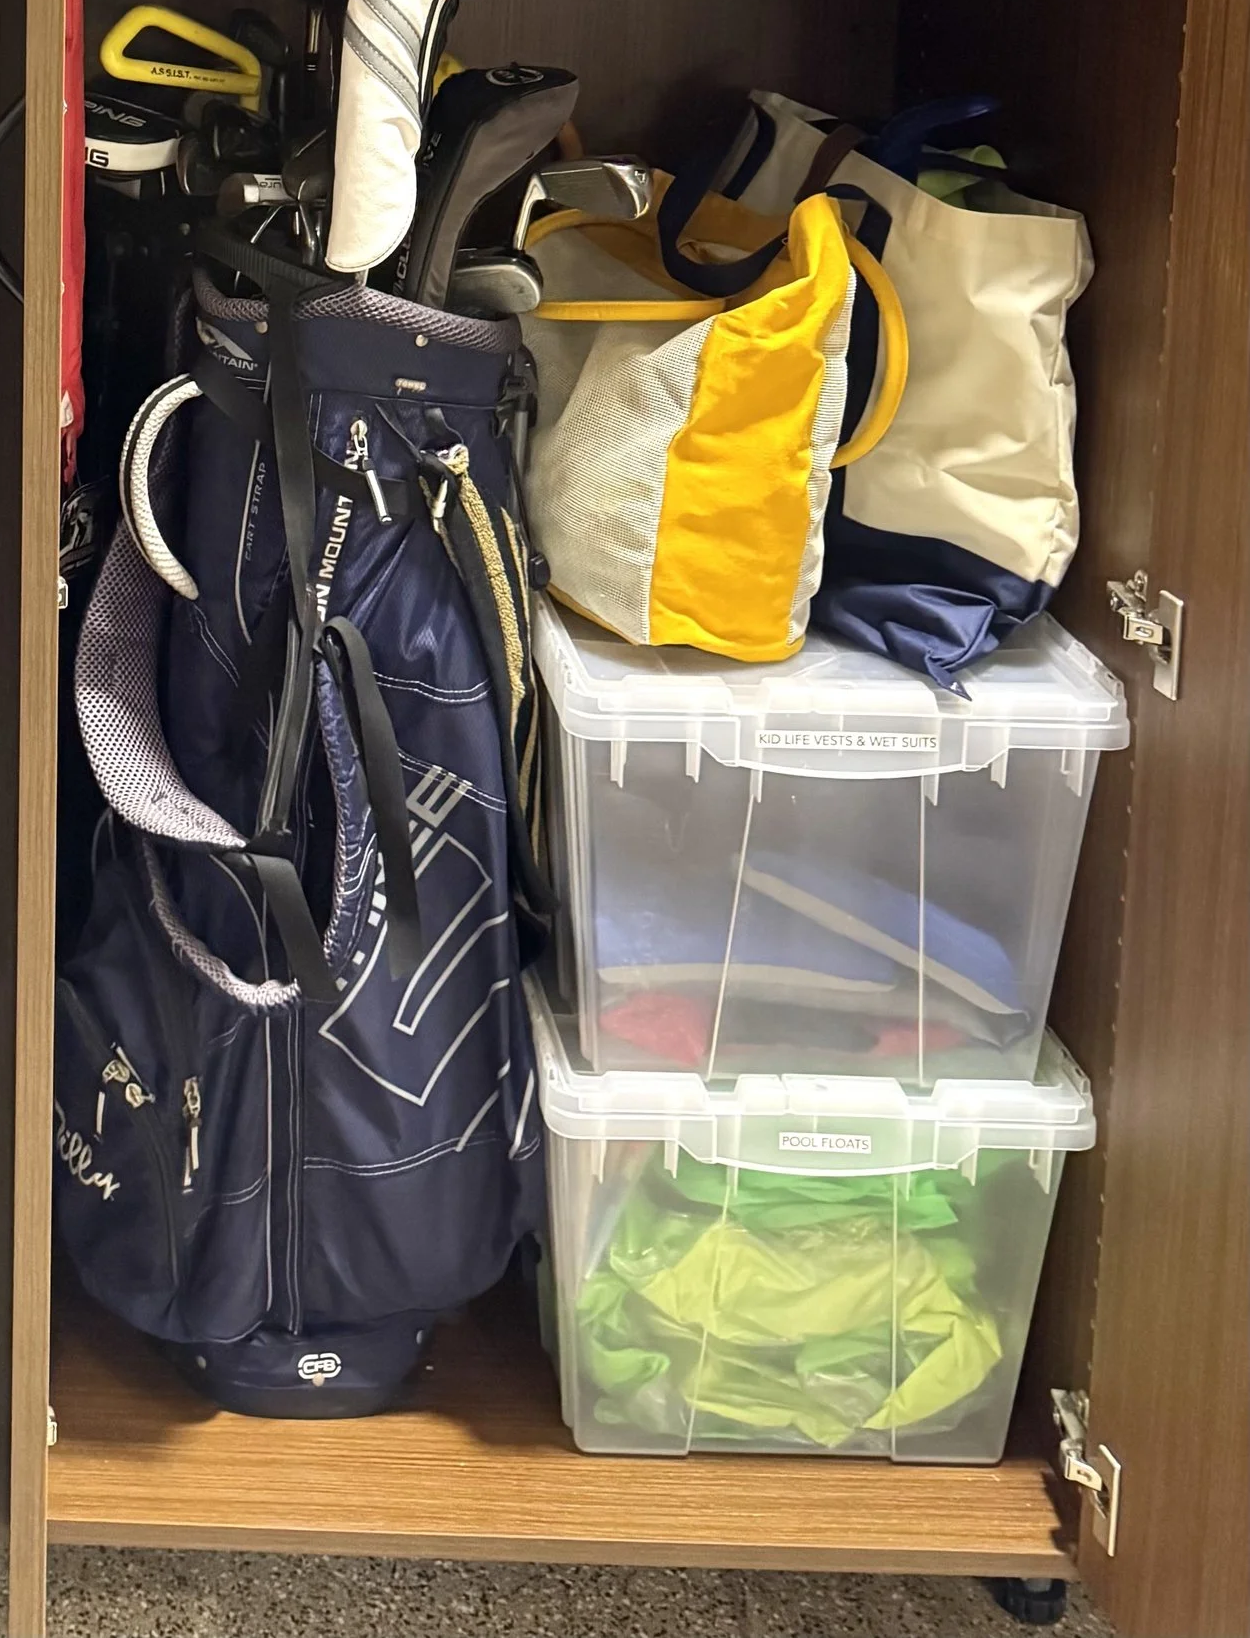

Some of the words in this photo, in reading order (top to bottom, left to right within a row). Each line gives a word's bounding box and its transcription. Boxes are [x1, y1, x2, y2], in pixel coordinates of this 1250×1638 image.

[251, 462, 266, 514] STRAP
[759, 733, 781, 745] KID
[784, 734, 811, 746] LIFE
[814, 735, 853, 747] VESTS
[856, 736, 866, 747] &
[869, 736, 898, 748] WET
[902, 737, 938, 749] SUITS
[782, 1136, 818, 1148] POOL
[821, 1137, 869, 1150] FLOATS
